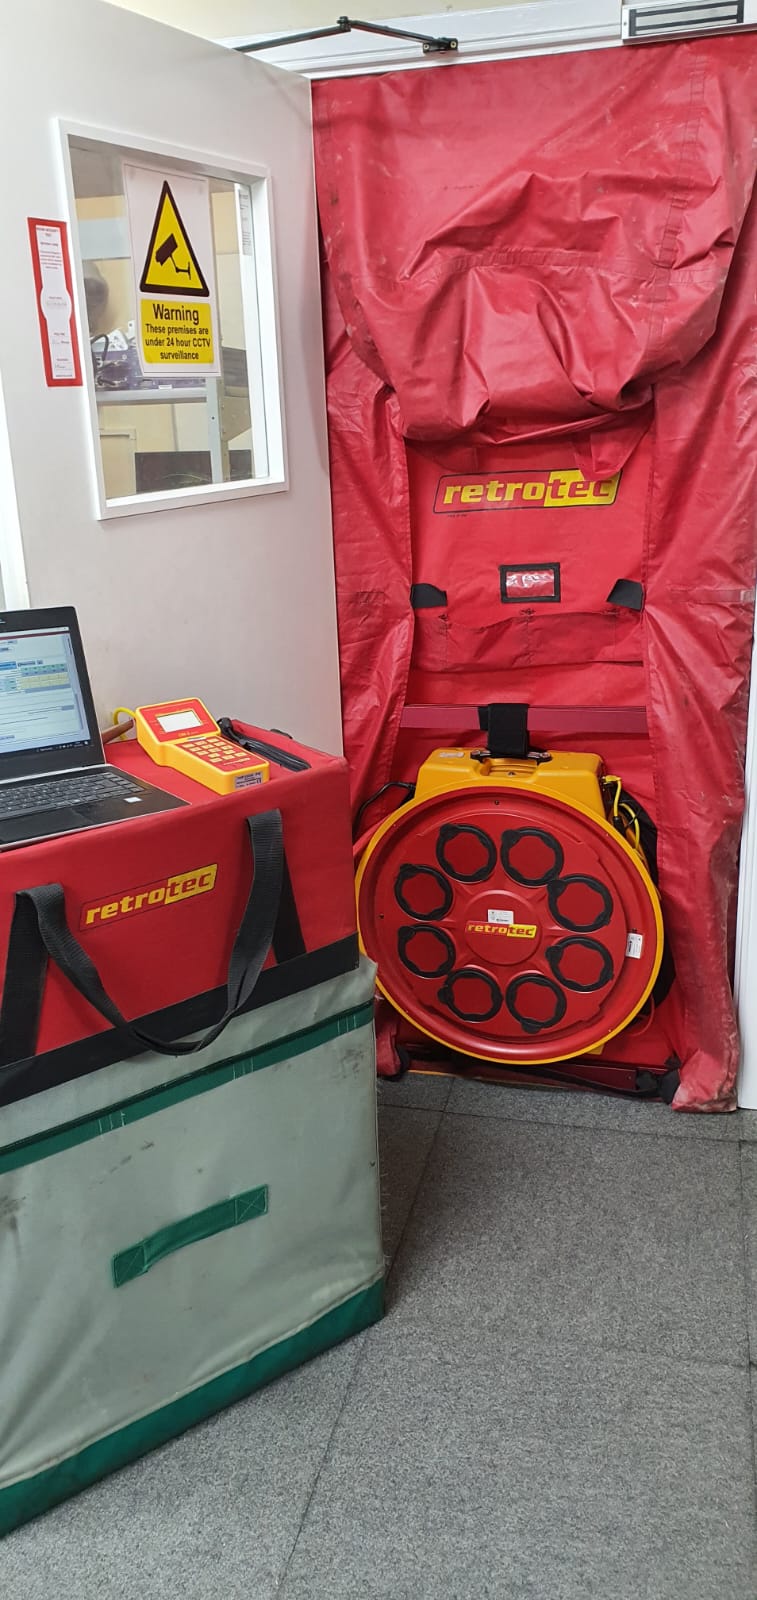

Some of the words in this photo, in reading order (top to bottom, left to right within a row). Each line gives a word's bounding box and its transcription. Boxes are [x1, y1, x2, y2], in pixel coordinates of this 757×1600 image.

[152, 303, 199, 326] Warning
[145, 323, 166, 334] These
[167, 325, 197, 336] premises
[198, 327, 209, 335] are
[145, 337, 165, 347] under
[166, 337, 175, 347] 24
[175, 337, 191, 347] hour
[192, 338, 211, 348] CCTV
[160, 350, 199, 360] surveillance
[442, 477, 613, 505] retrotec
[85, 872, 212, 925] retrotec
[467, 923, 535, 936] retrotec
